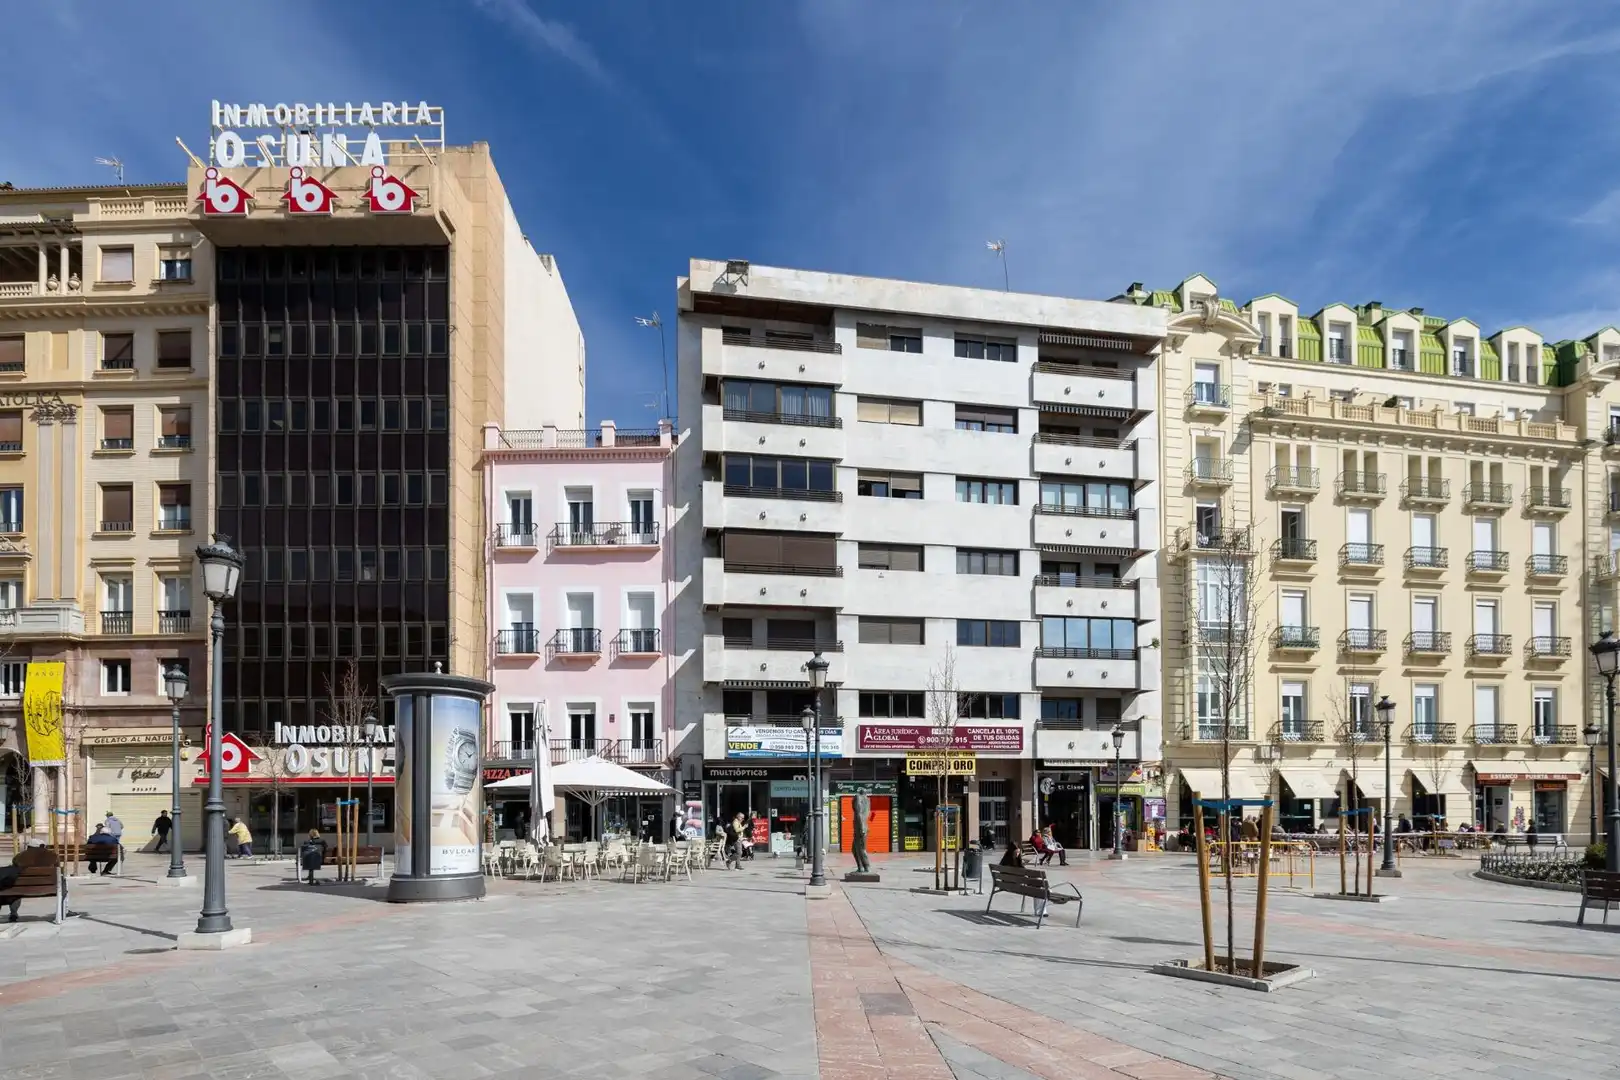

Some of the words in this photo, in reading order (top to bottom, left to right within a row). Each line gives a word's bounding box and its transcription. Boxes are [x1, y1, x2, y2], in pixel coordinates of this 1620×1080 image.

[211, 98, 432, 128] INMOBILIARIA
[214, 131, 386, 168] OSUNA
[890, 727, 919, 735] JURÍDICA
[954, 736, 968, 744] 915
[728, 742, 759, 750] VENDE
[953, 760, 974, 771] ORO
[482, 768, 511, 780] PIZZA
